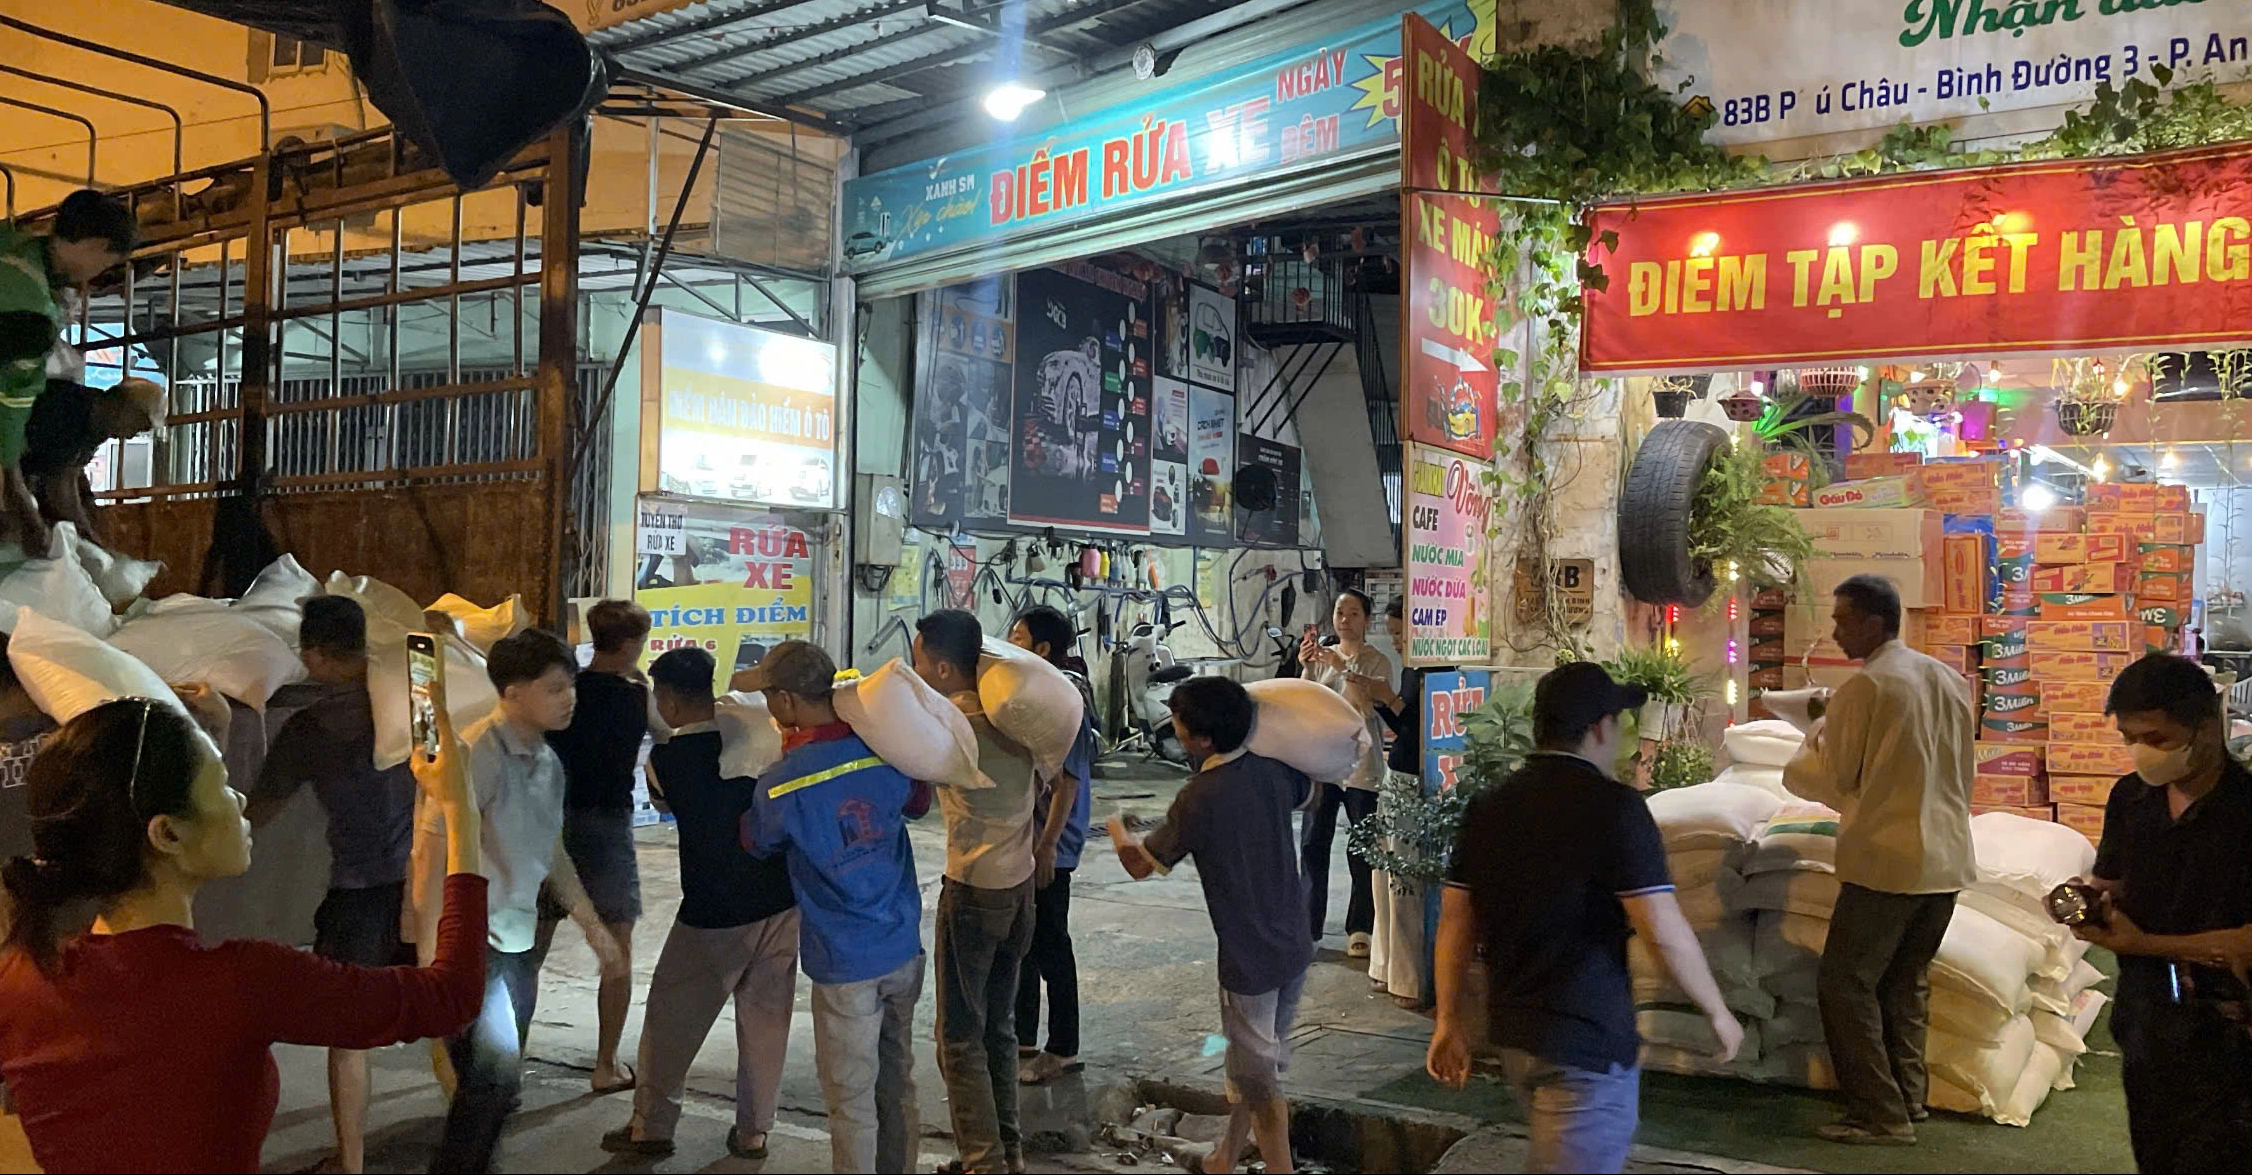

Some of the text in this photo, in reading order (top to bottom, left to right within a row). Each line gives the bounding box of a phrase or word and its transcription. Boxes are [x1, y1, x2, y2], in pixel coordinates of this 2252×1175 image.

[1899, 0, 2086, 48] Nhận
[1276, 47, 1348, 103] NGÀY
[1417, 48, 1466, 129] RỬA
[1723, 97, 1771, 128] 83B
[1841, 77, 1909, 112] Châu
[1936, 62, 2002, 101] Bình
[2011, 53, 2110, 91] Đường
[2122, 45, 2139, 77] 3
[2169, 37, 2192, 69] P.
[2203, 33, 2248, 66] An
[1102, 112, 1193, 200] RỬA
[1203, 96, 1271, 176] XE
[926, 174, 975, 201] XANH SM
[1417, 197, 1446, 253] XE
[1918, 214, 2039, 299] KẾT
[2058, 214, 2252, 291] HÀNG
[1428, 277, 1484, 346] 30K
[803, 405, 813, 438] Ô
[815, 408, 830, 441] TÔ
[728, 520, 810, 559] RỬA
[1412, 505, 1439, 531] CAFE
[664, 536, 675, 551] XE
[743, 561, 793, 590] XE
[650, 597, 808, 628] TÍCH ĐIỂM
[1412, 607, 1433, 626] CAM
